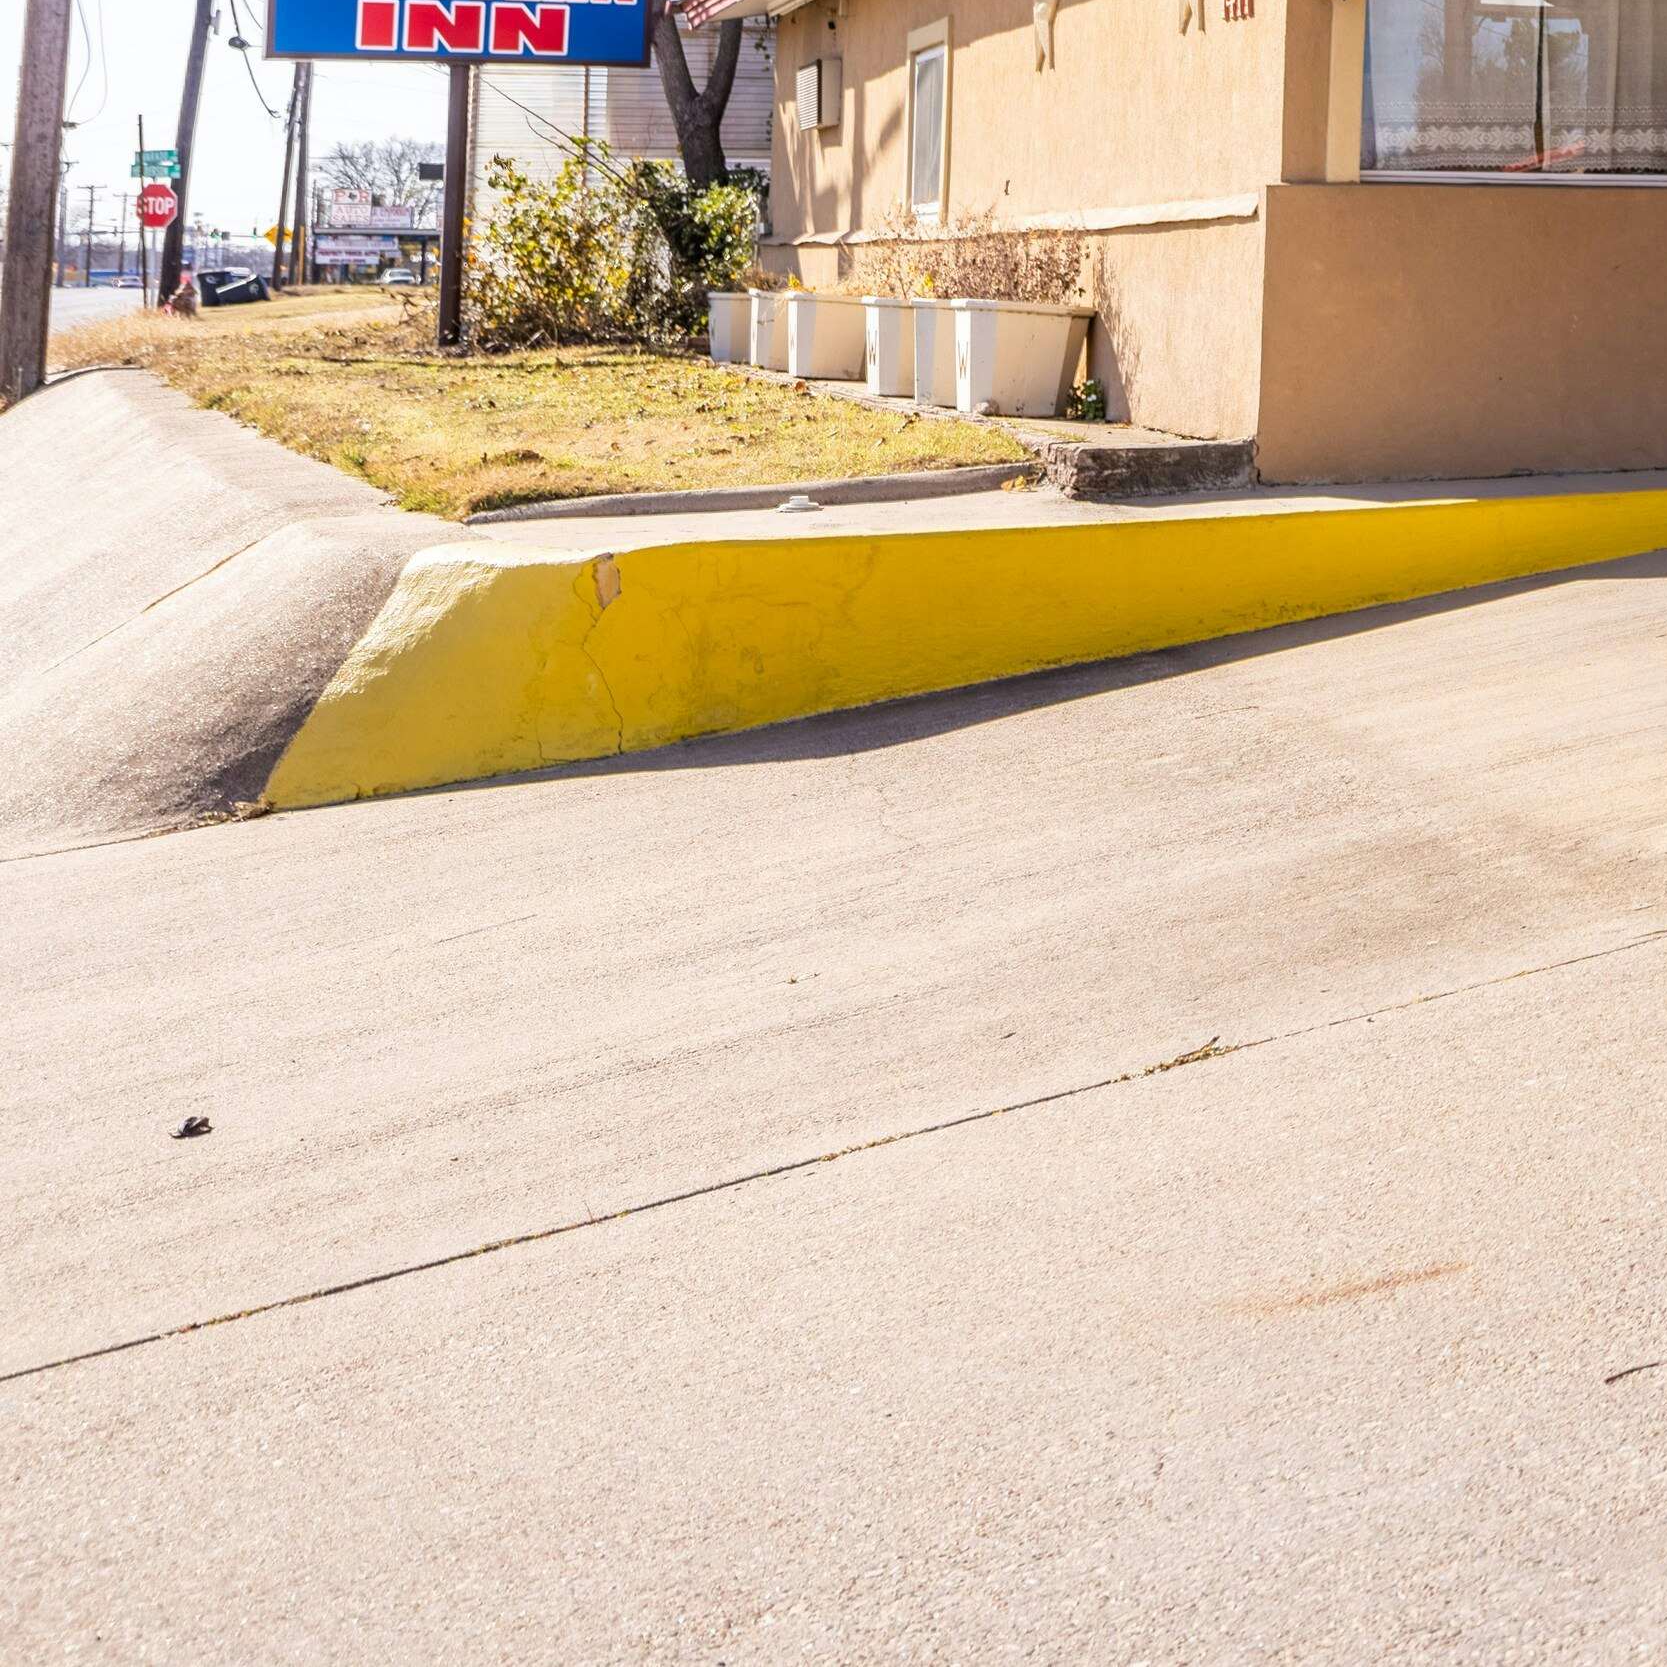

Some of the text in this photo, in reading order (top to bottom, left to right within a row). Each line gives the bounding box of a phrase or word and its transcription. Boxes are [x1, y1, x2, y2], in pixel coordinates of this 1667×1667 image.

[138, 196, 175, 215] STOP
[338, 205, 368, 214] AUTO
[332, 214, 370, 224] SALES
